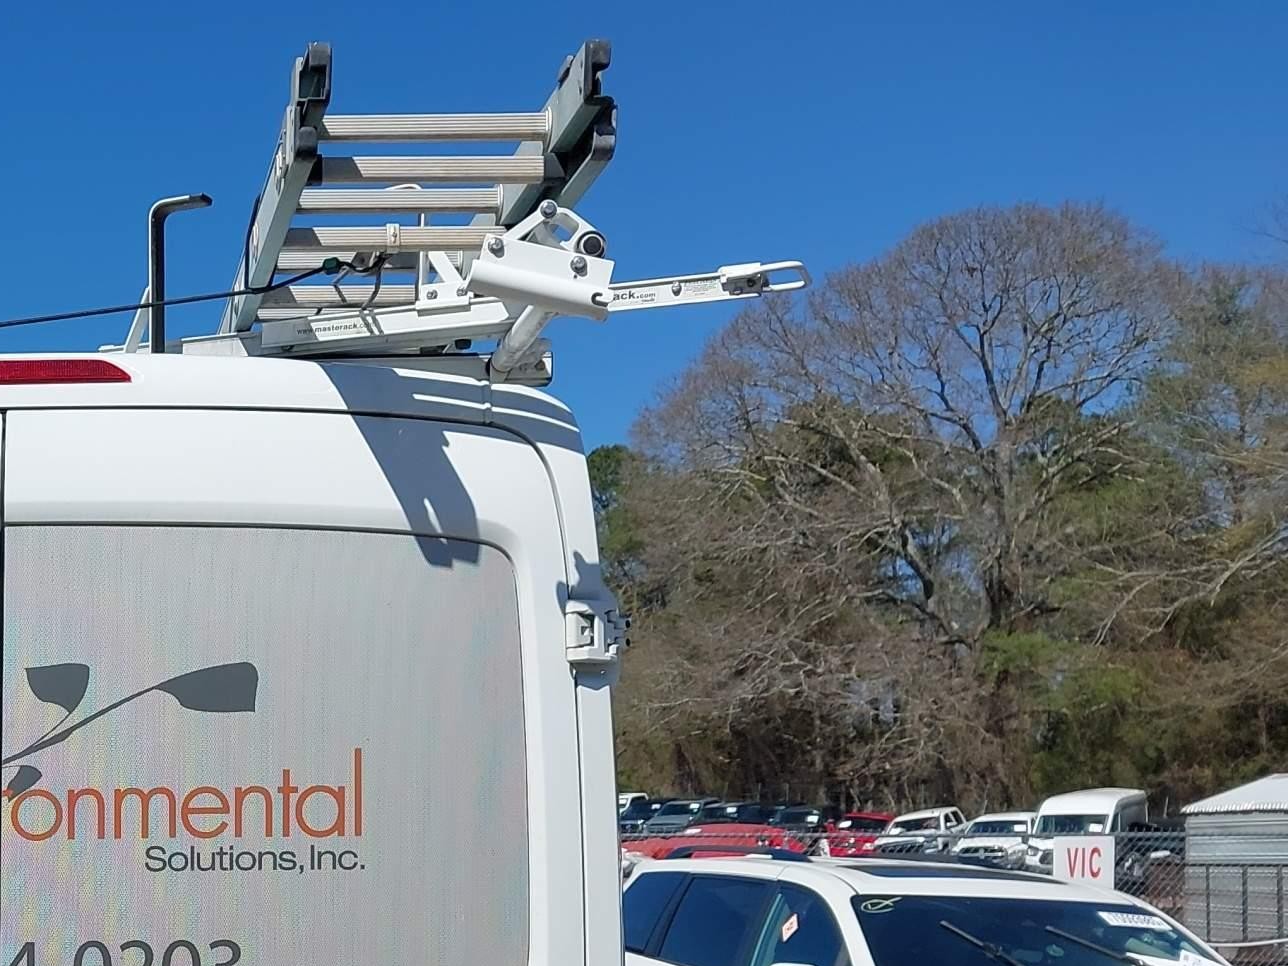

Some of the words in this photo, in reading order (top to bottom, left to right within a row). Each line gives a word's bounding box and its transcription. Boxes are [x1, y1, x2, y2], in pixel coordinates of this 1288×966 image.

[612, 289, 656, 302] ack.com
[144, 845, 306, 875] Solutions,
[310, 844, 367, 873] Inc.
[1067, 847, 1102, 879] VIC
